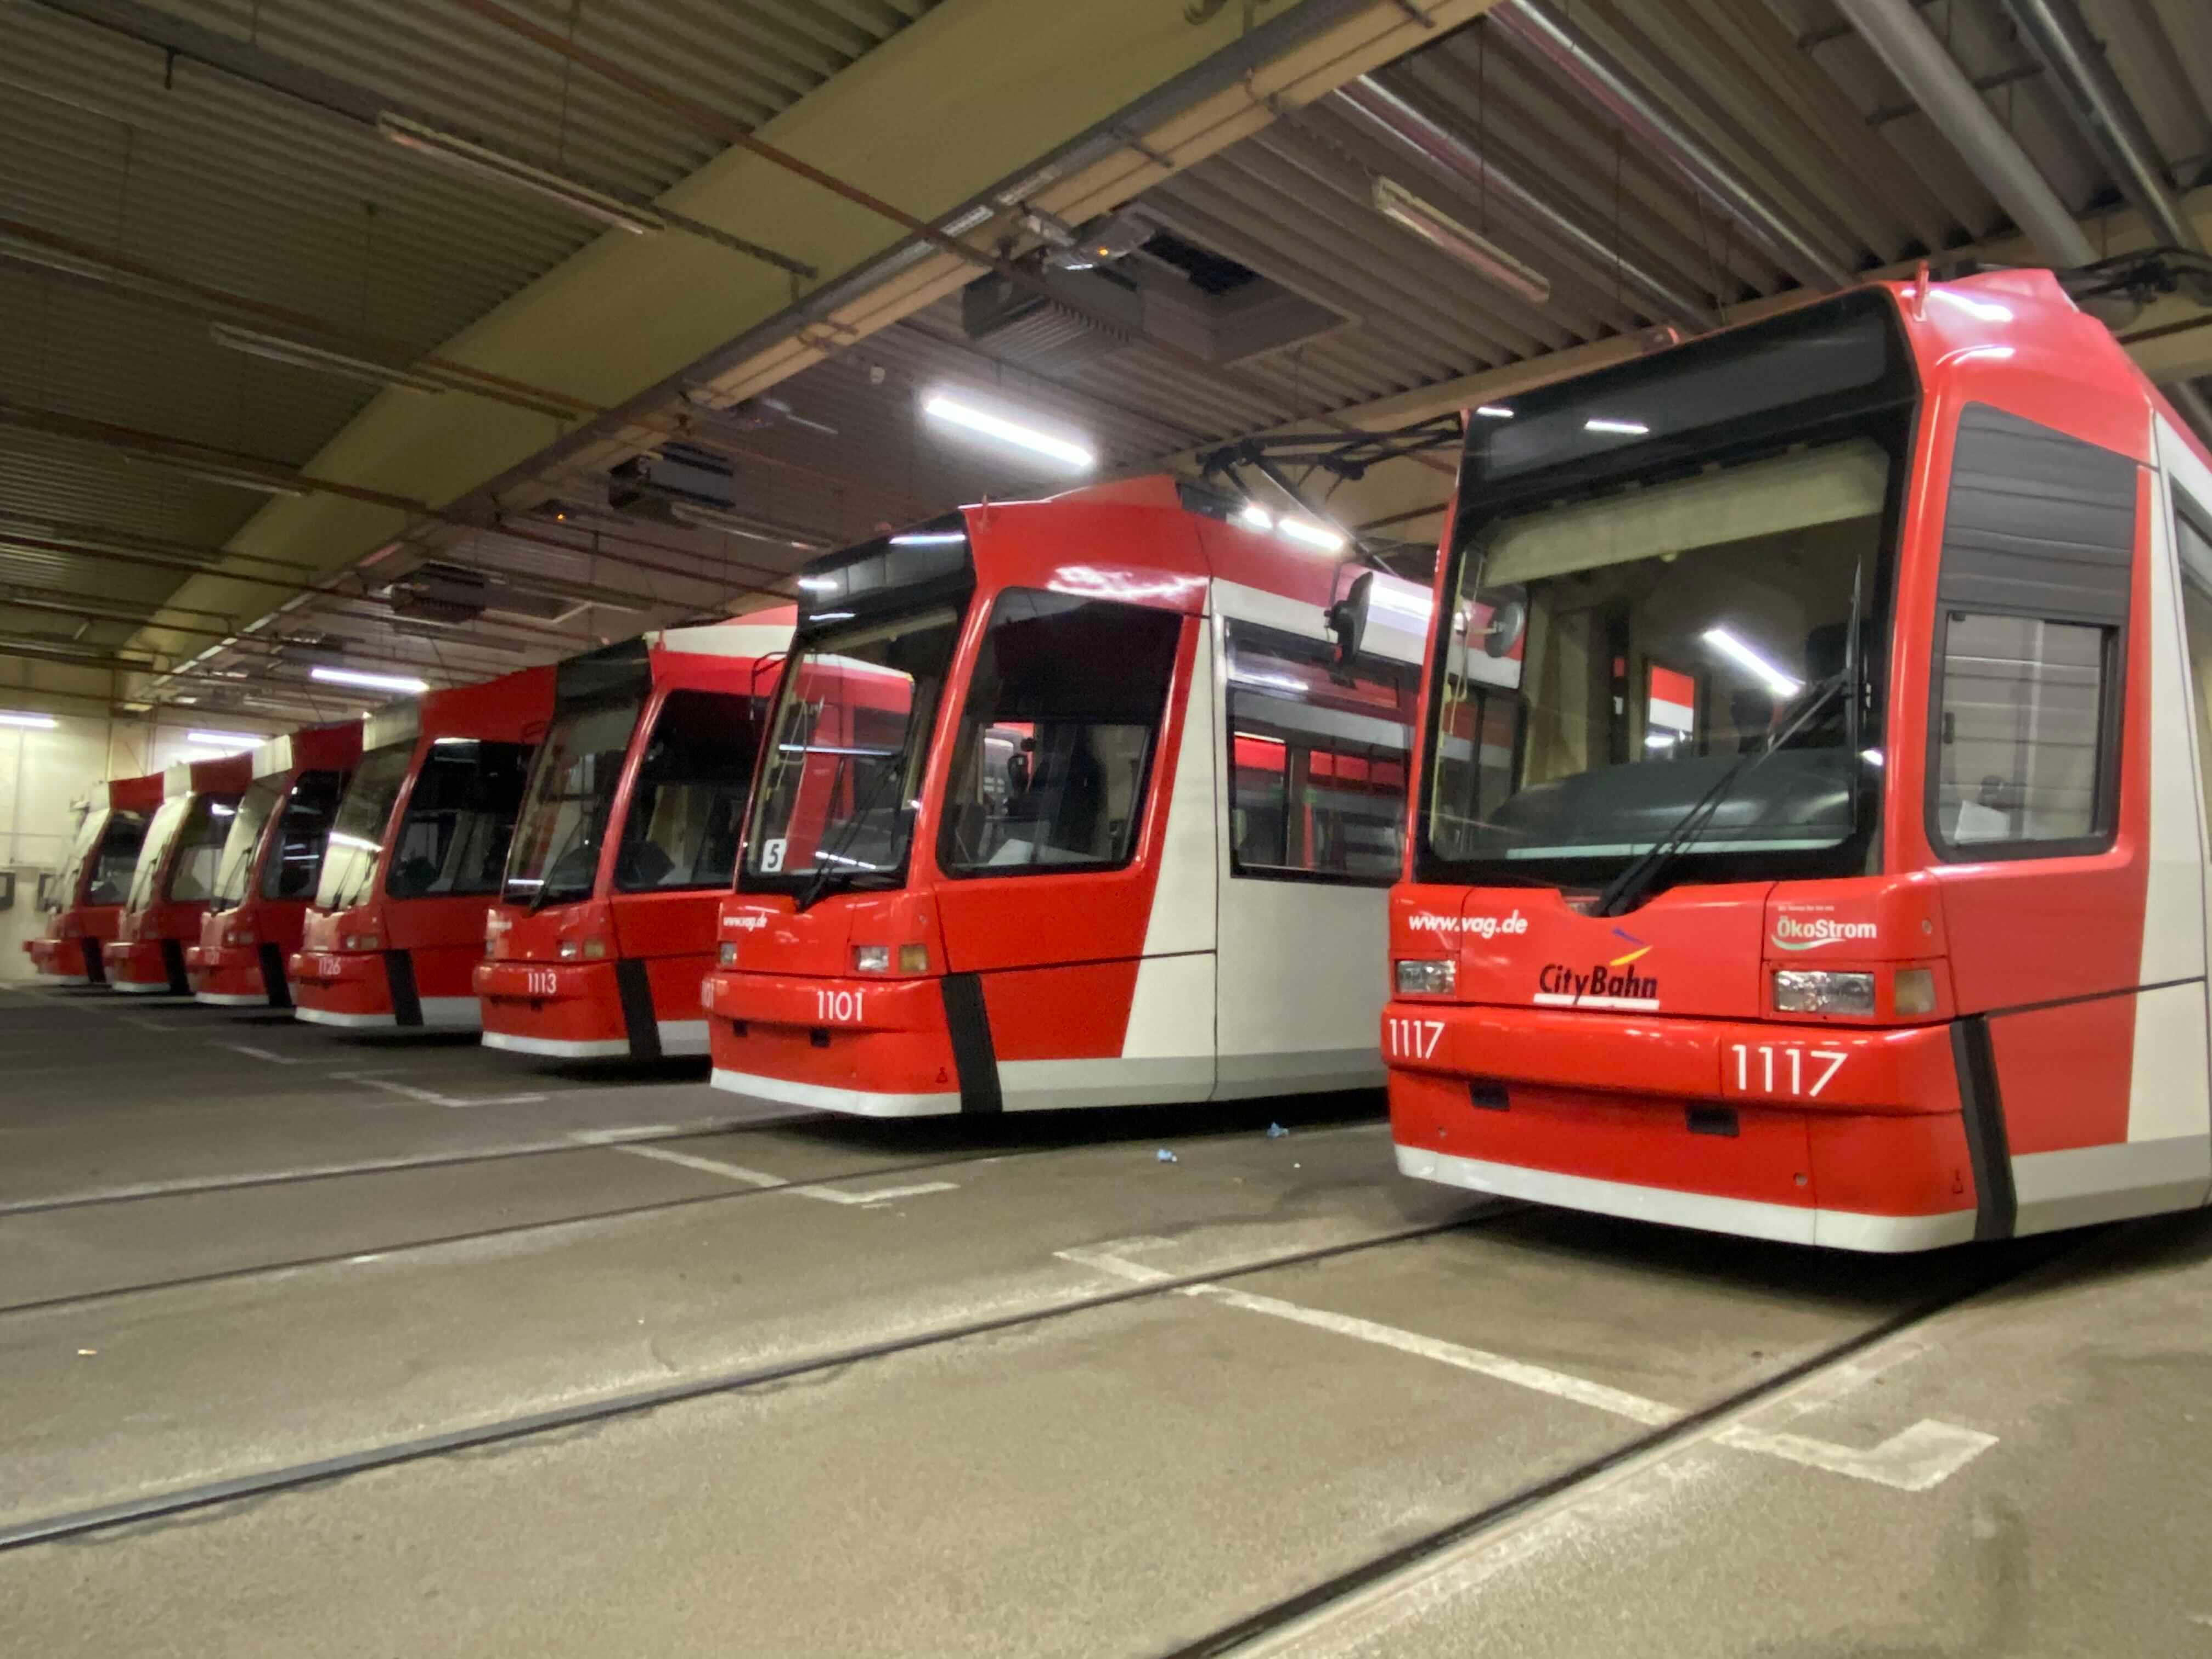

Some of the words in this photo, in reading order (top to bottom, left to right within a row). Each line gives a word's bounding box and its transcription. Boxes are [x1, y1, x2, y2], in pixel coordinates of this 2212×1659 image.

[768, 843, 780, 868] 5
[1408, 909, 1528, 939] www.vag.de
[1777, 915, 1877, 939] ÖkoStrom
[528, 972, 556, 995] 1113
[1539, 963, 1657, 1005] CityBahn
[817, 990, 862, 1022] 1101
[1389, 1018, 1446, 1059] 1117
[1731, 1044, 1848, 1097] 1117
